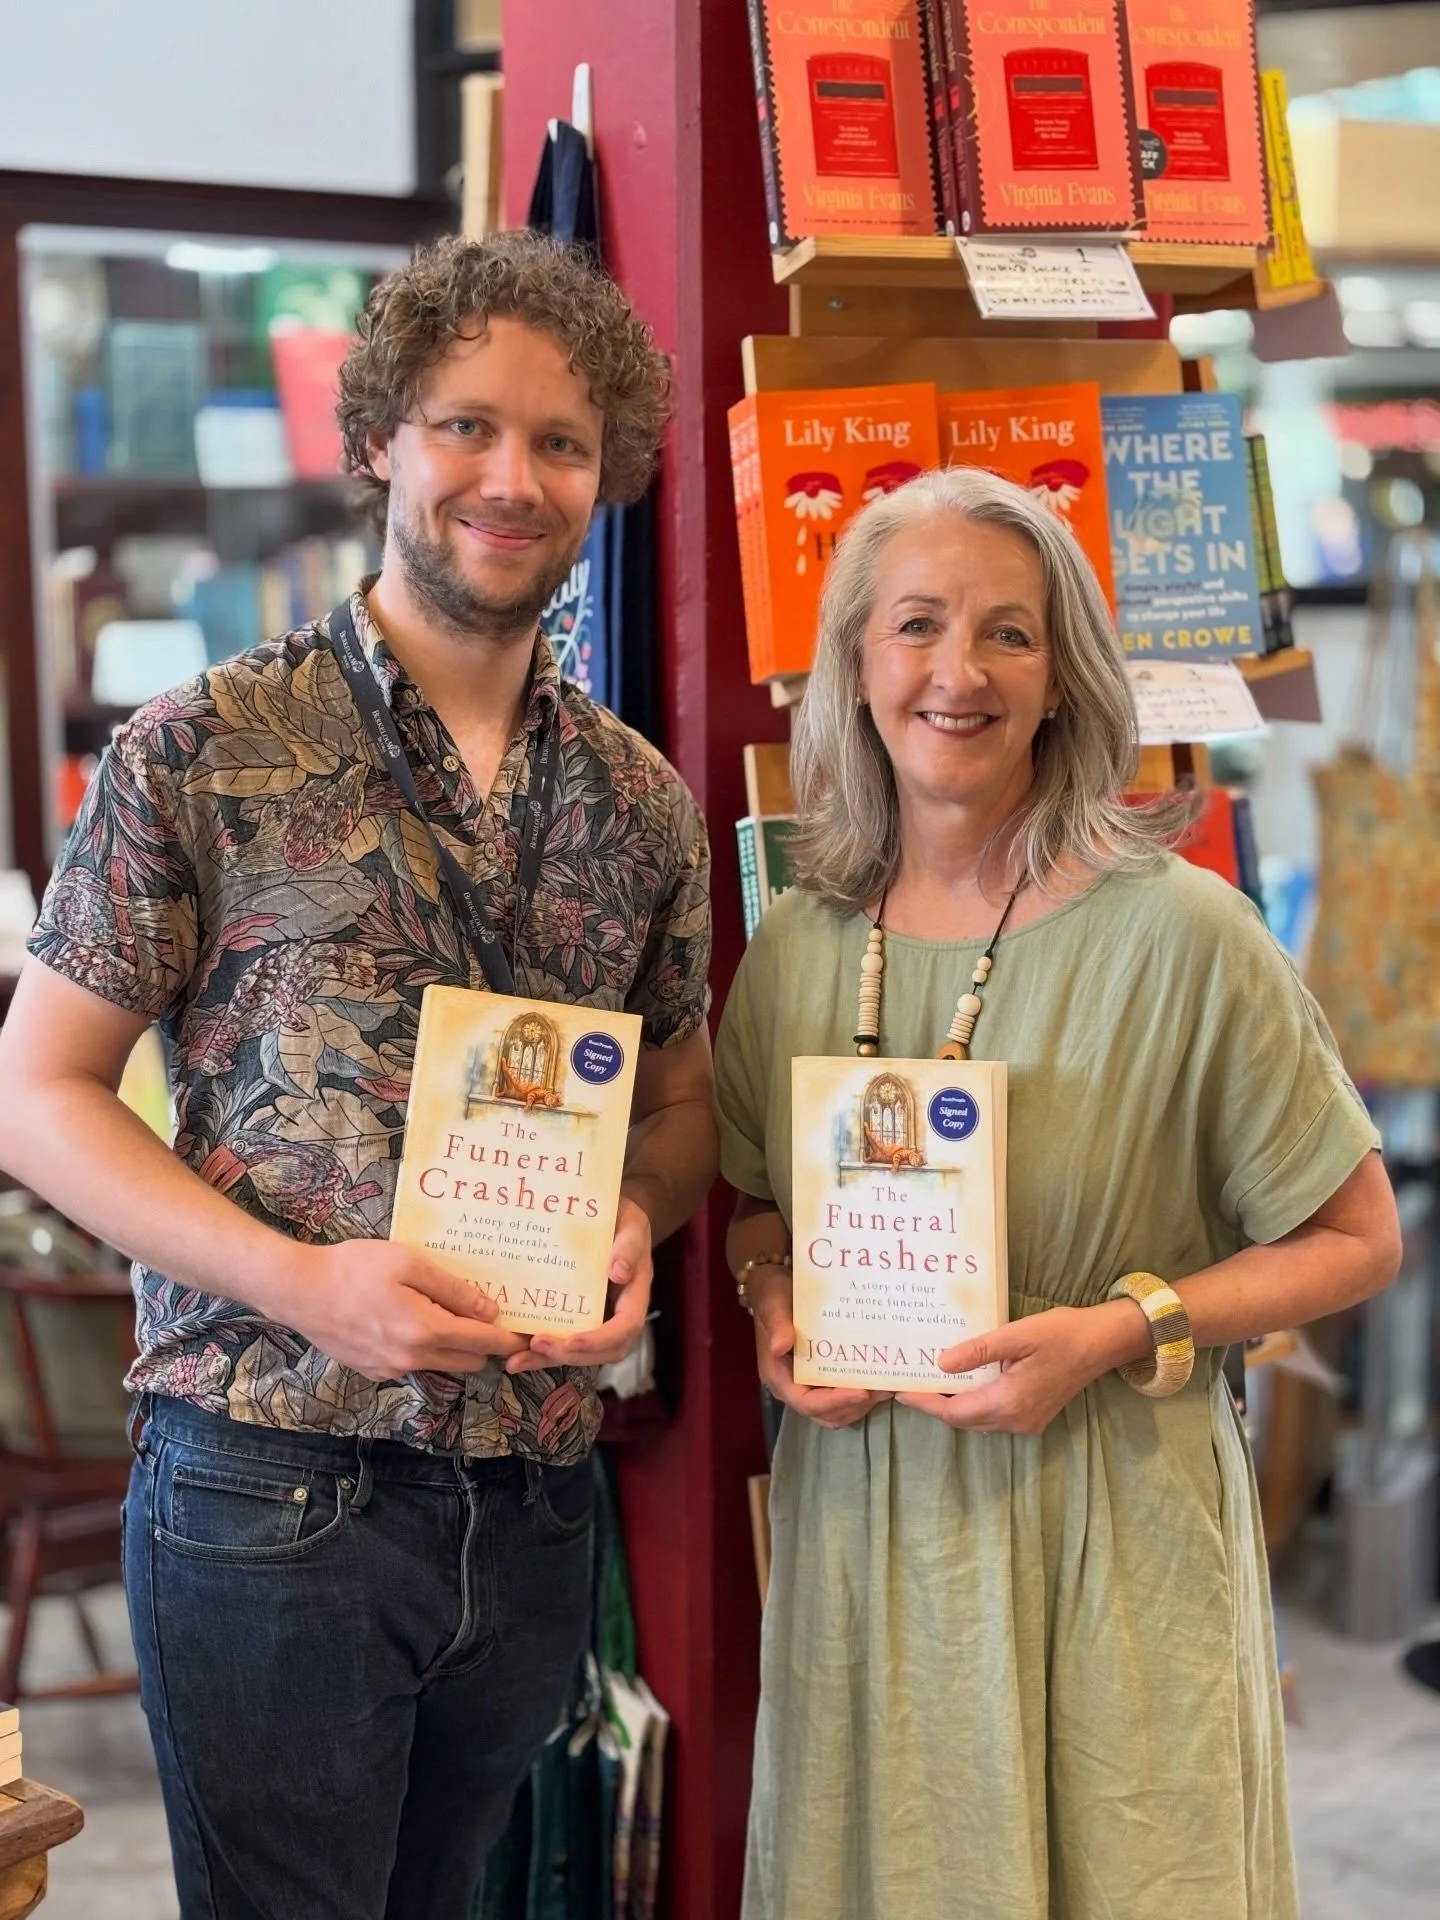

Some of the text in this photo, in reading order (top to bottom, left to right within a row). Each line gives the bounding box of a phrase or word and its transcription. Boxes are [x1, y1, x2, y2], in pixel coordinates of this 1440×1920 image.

[776, 10, 911, 42] Correspondent
[976, 10, 1107, 40] Correspondent
[1132, 24, 1242, 51] orrespondent
[1140, 150, 1160, 161] AFF
[1141, 159, 1156, 169] CK
[802, 183, 916, 213] Virginia Evans
[1000, 182, 1116, 211] Virginia Evans
[783, 416, 912, 453] Lily King
[950, 419, 1001, 452] Lily
[1008, 416, 1076, 447] King
[1104, 430, 1234, 466] WHERE
[1127, 469, 1203, 501] THE
[1113, 504, 1228, 540] LIGHT
[1111, 539, 1248, 578] GETS IN
[1121, 625, 1252, 652] EN CROWE
[583, 1048, 614, 1063] Signed
[584, 1060, 607, 1075] Copy
[938, 1106, 969, 1118] Signed
[942, 1118, 965, 1130] Copy
[501, 1121, 537, 1141] The
[443, 1133, 584, 1177] Funeral
[419, 1167, 598, 1218] Crashers
[872, 1186, 908, 1203] The
[459, 1213, 553, 1235] A story of four
[825, 1203, 958, 1234] Funeral
[446, 1227, 459, 1237] or
[463, 1230, 494, 1242] more
[498, 1233, 549, 1249] funerals
[424, 1240, 578, 1270] and at least one wedding
[808, 1238, 979, 1274] Crashers
[849, 1280, 936, 1295] A story of four
[521, 1287, 592, 1316] NELL
[838, 1295, 850, 1304] or
[855, 1297, 883, 1307] more
[887, 1297, 936, 1309] funerals
[500, 1308, 575, 1325] STSELLING AUTHOR
[821, 1309, 967, 1327] and at least one wedding
[806, 1339, 908, 1366] JOANNA
[818, 1366, 838, 1374] FROM
[892, 1371, 941, 1380] BESTSELLING
